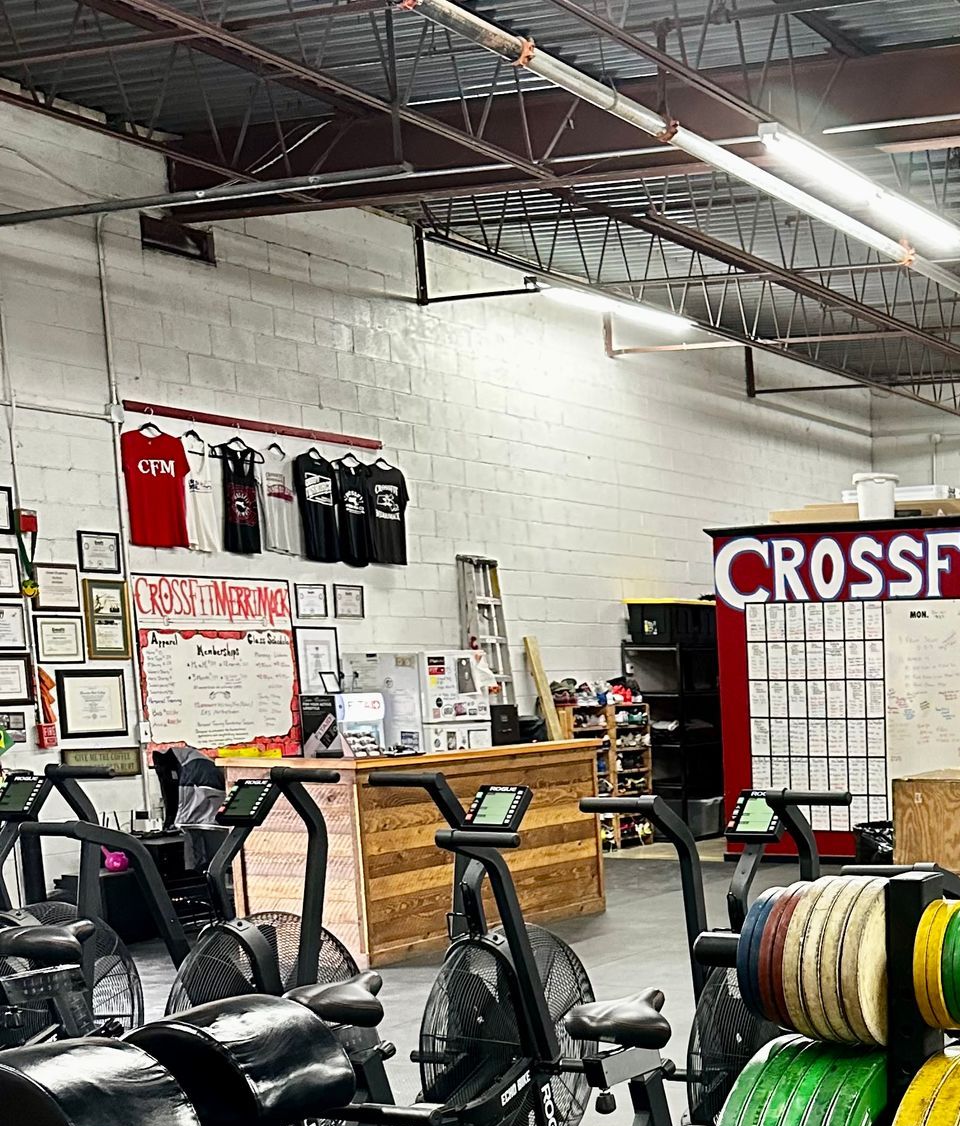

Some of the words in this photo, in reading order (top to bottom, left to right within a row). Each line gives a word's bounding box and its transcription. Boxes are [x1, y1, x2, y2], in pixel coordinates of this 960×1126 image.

[137, 459, 176, 478] CFM
[909, 610, 929, 619] MON.
[151, 631, 178, 647] Apparel
[196, 642, 241, 660] Memberships
